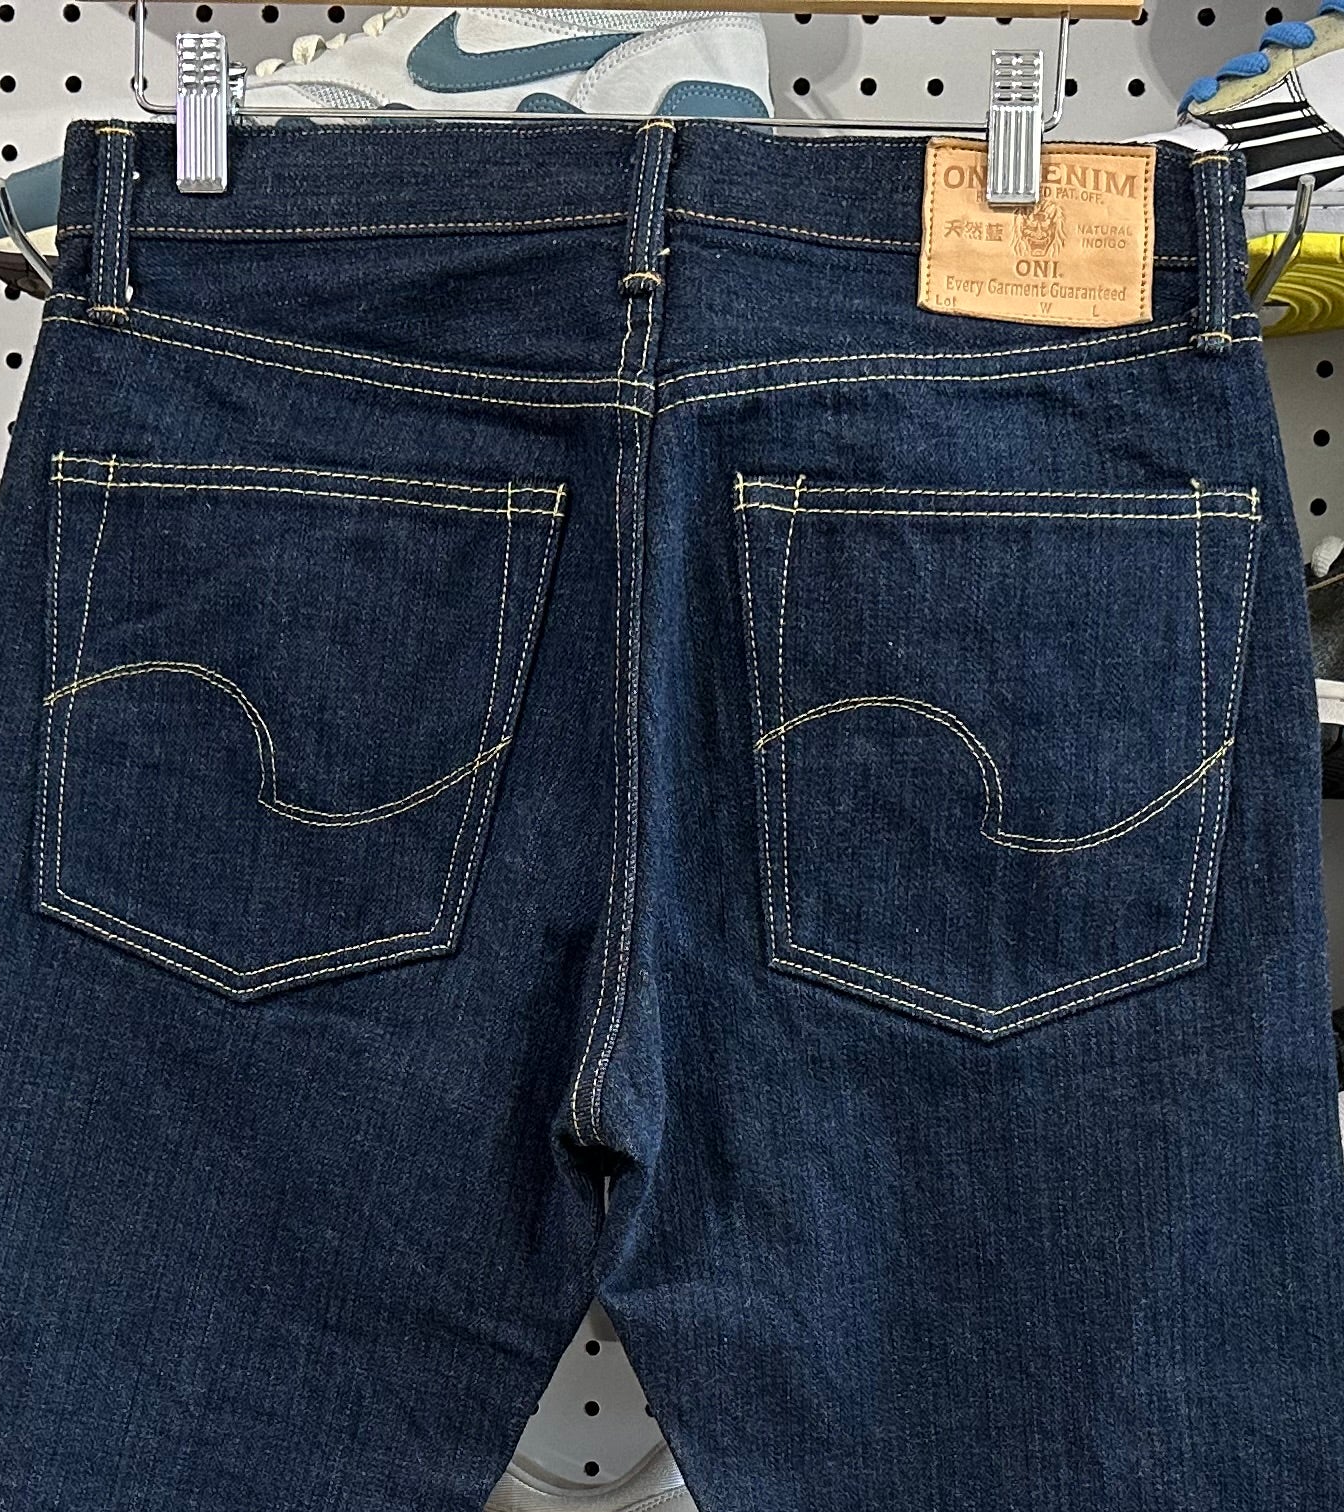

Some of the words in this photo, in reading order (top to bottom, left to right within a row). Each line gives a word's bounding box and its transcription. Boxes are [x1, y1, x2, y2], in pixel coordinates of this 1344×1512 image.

[943, 165, 988, 189] ON
[1040, 162, 1137, 200] ENIM
[1077, 223, 1133, 237] NATURAL
[1081, 238, 1126, 249] INDIGO
[946, 275, 984, 297] Every
[987, 278, 1046, 298] Garment
[1049, 282, 1127, 302] Guaranteed
